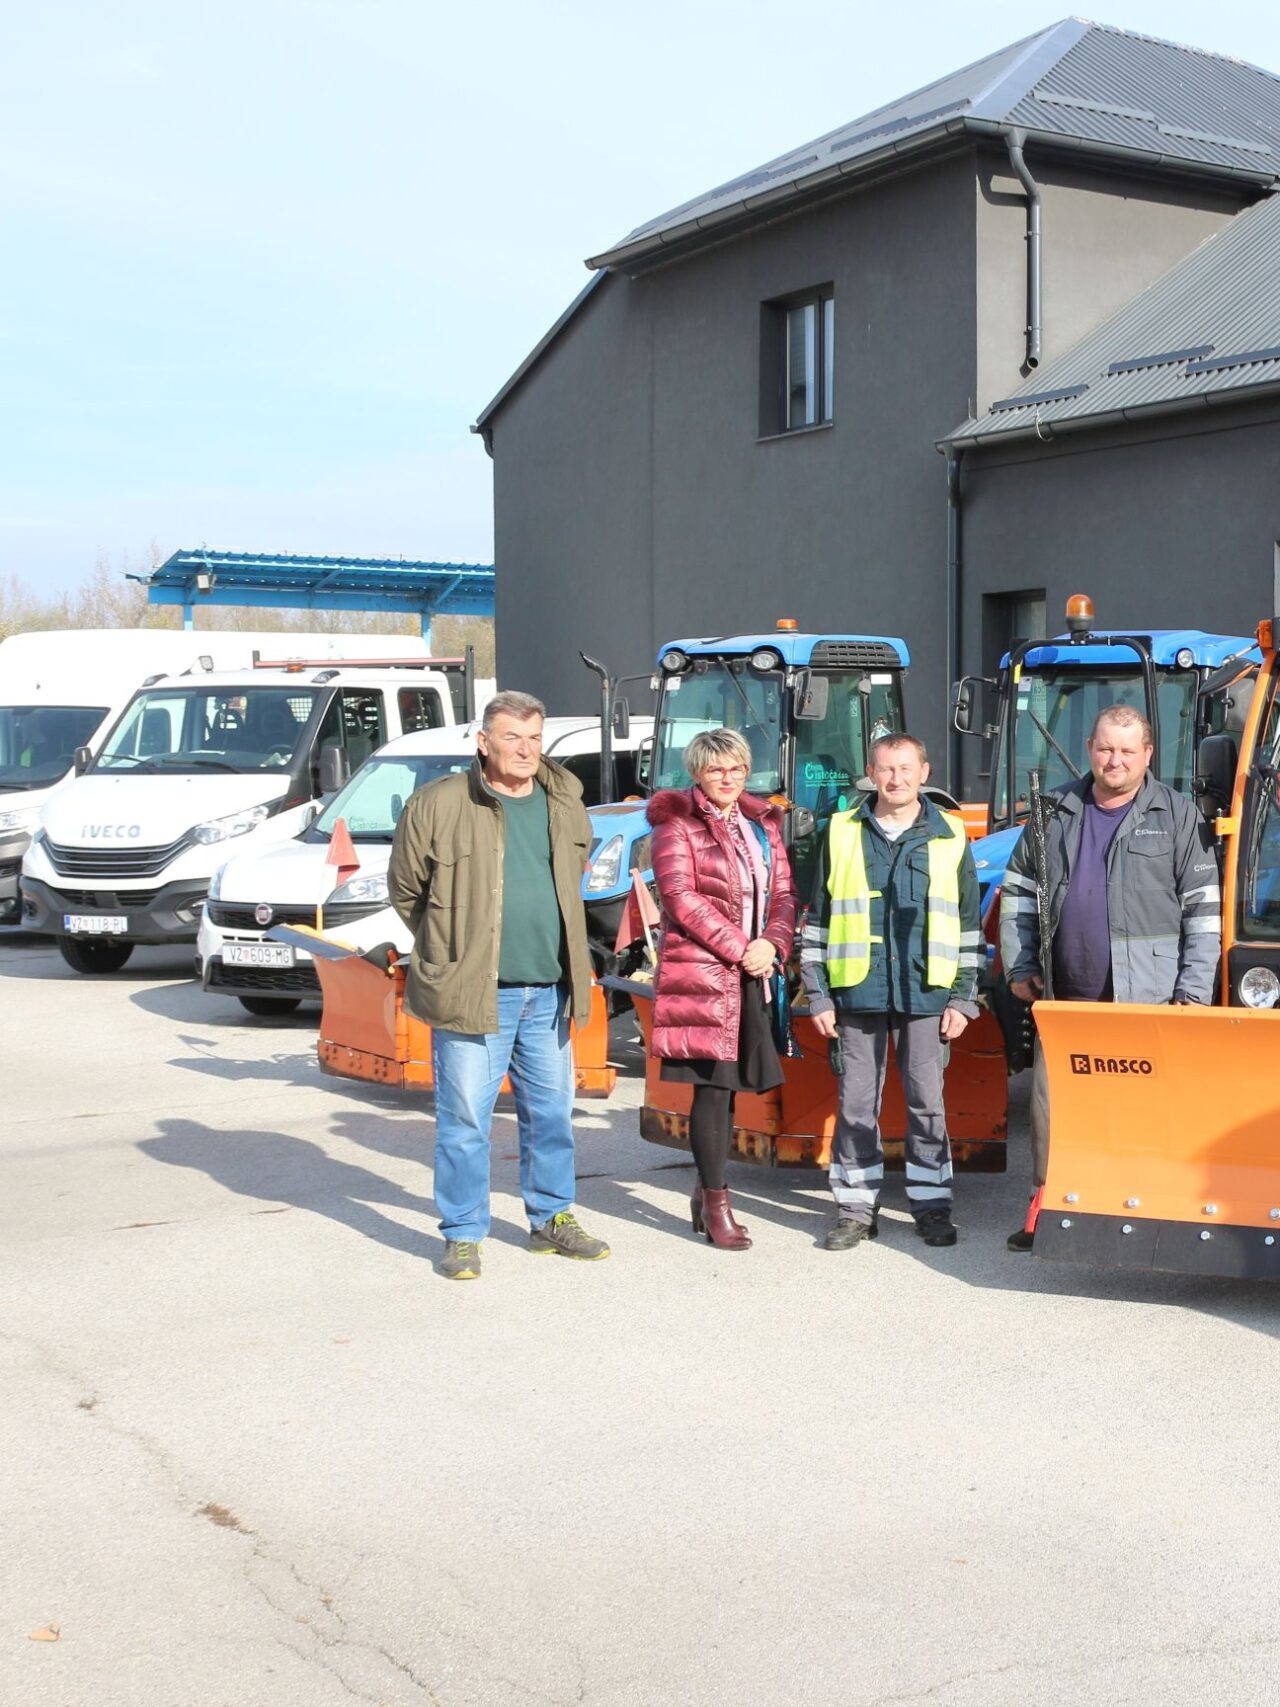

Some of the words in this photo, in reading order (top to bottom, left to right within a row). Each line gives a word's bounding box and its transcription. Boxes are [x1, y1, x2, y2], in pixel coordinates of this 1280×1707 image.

[81, 825, 141, 838] IVECO
[230, 947, 242, 961] VZ
[250, 948, 290, 963] 609-MG
[1094, 1058, 1153, 1075] RASCO
